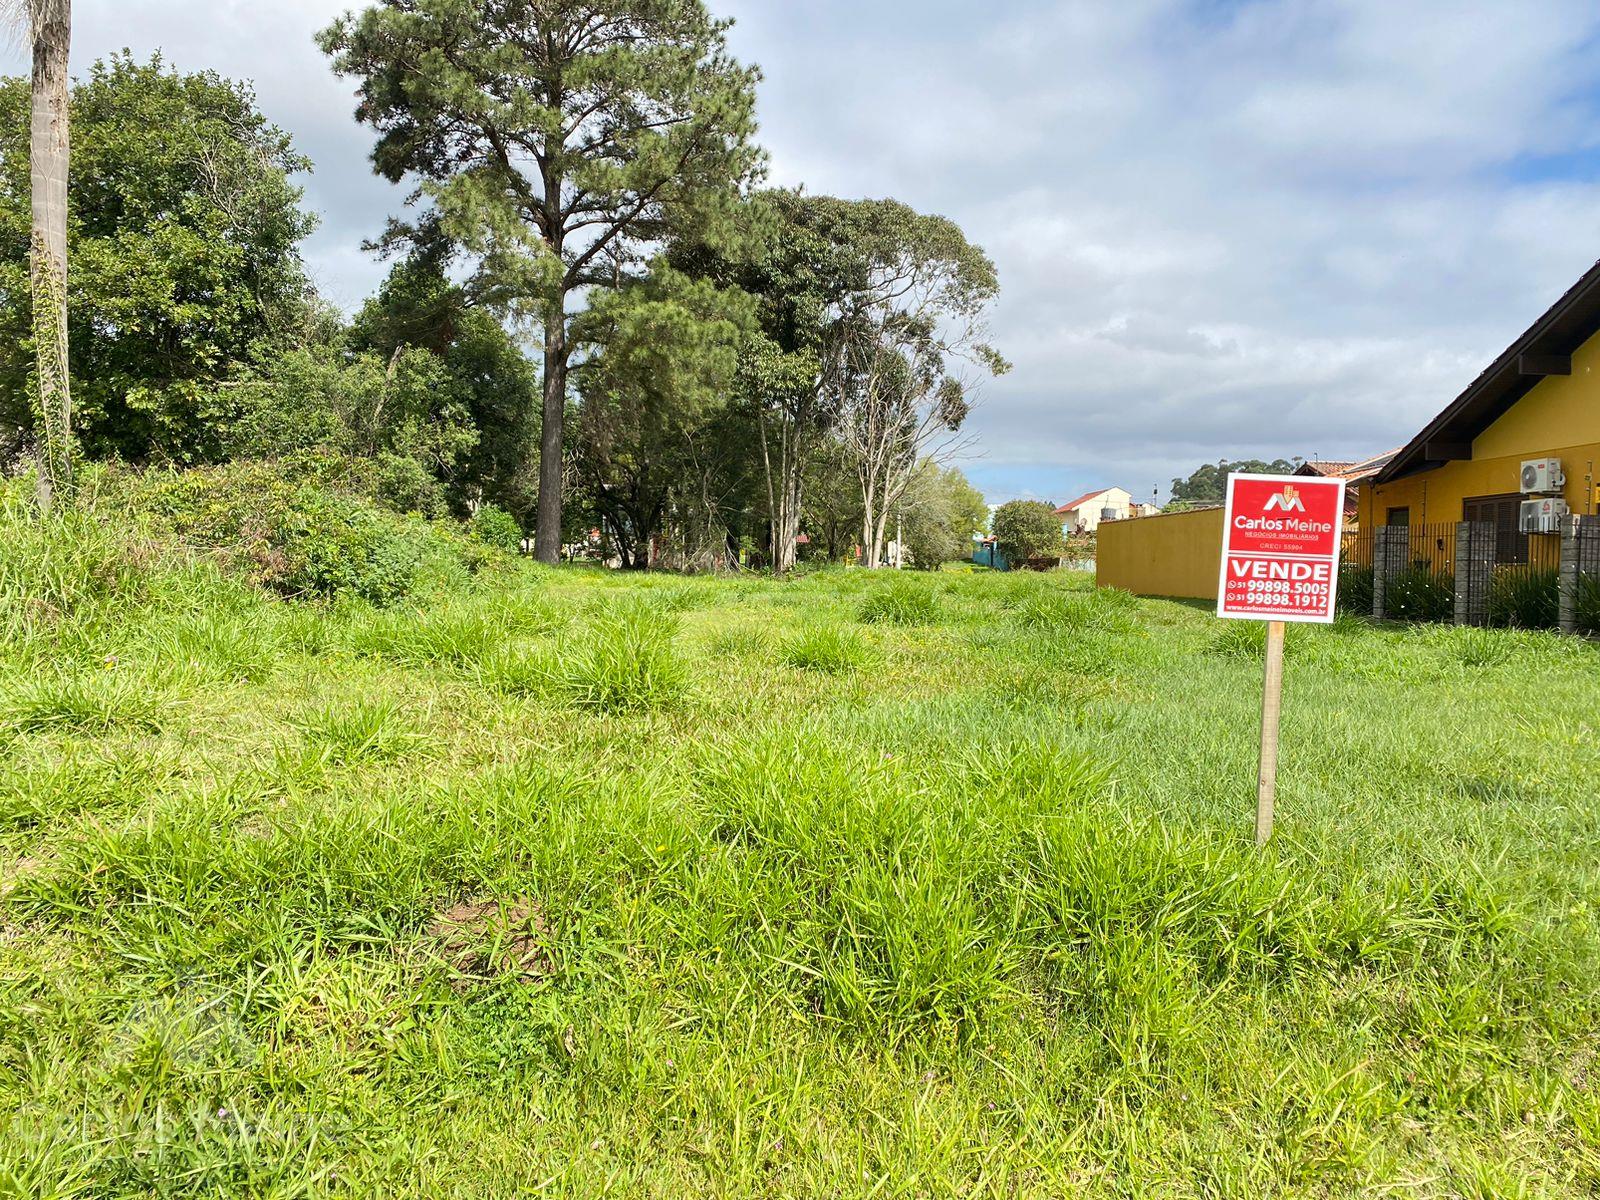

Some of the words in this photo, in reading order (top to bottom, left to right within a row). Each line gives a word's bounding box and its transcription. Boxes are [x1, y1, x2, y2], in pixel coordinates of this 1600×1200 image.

[1234, 515, 1283, 530] Carlos
[1285, 518, 1331, 533] Meine
[1231, 559, 1330, 581] VENDE
[1247, 580, 1328, 595] 99898.5005
[1246, 592, 1327, 607] 99898.1912
